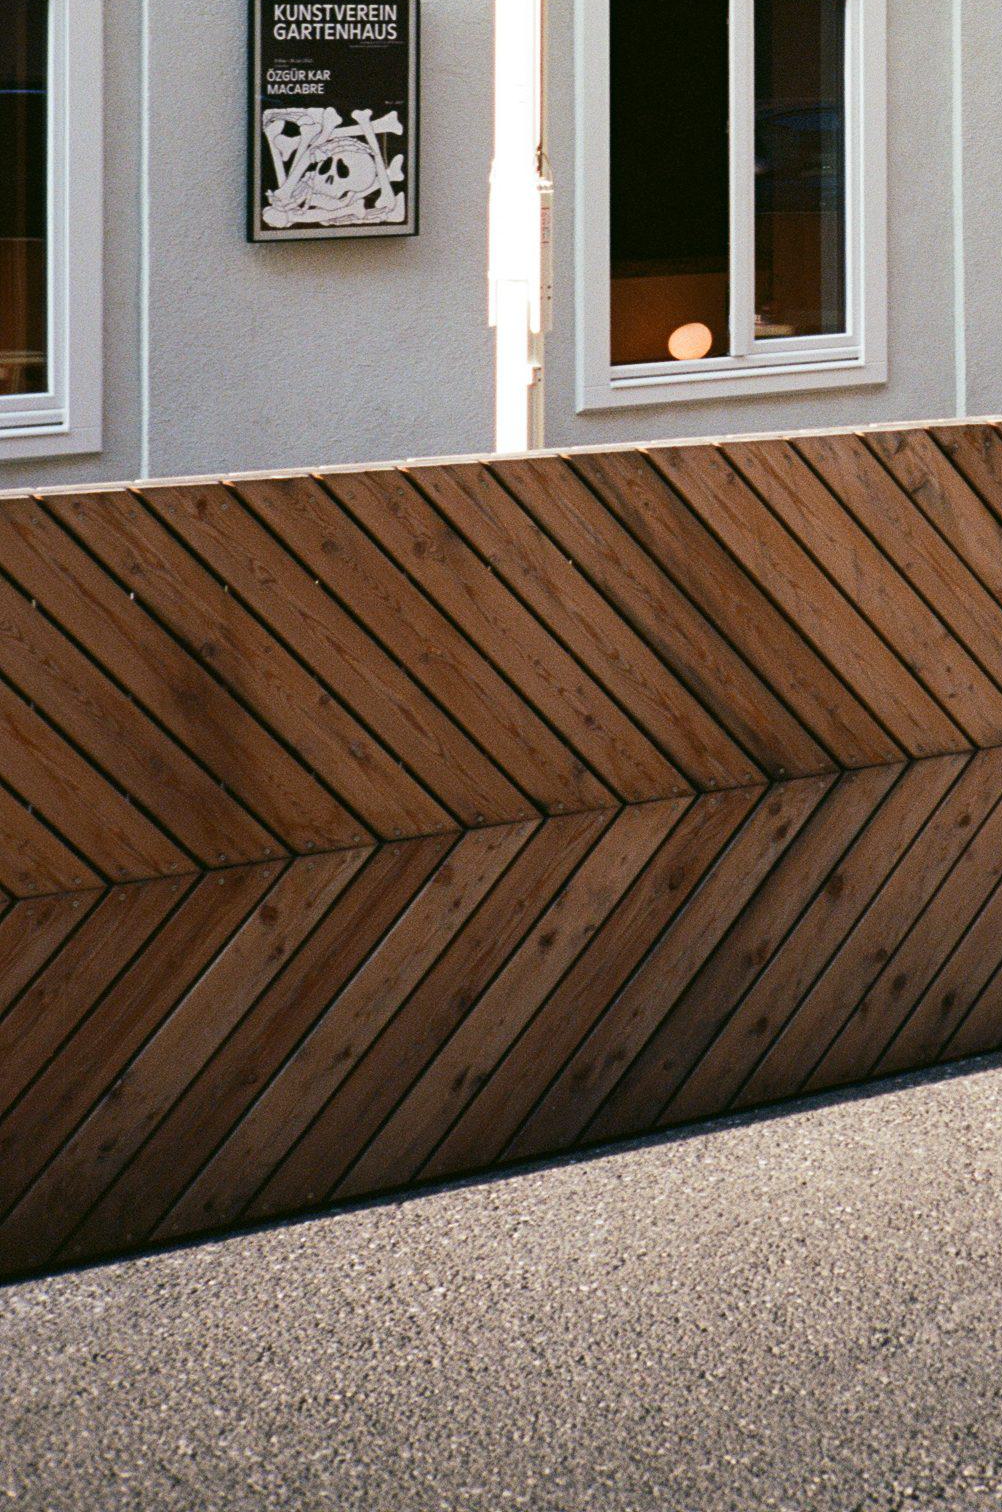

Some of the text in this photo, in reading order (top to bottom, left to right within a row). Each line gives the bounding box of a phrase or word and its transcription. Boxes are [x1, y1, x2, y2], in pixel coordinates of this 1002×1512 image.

[274, 4, 397, 21] KUNSTVEREIN
[273, 23, 398, 40] GARTENHAUS
[266, 68, 331, 82] ÖZGÜR KAR
[267, 83, 325, 95] MACABRE
